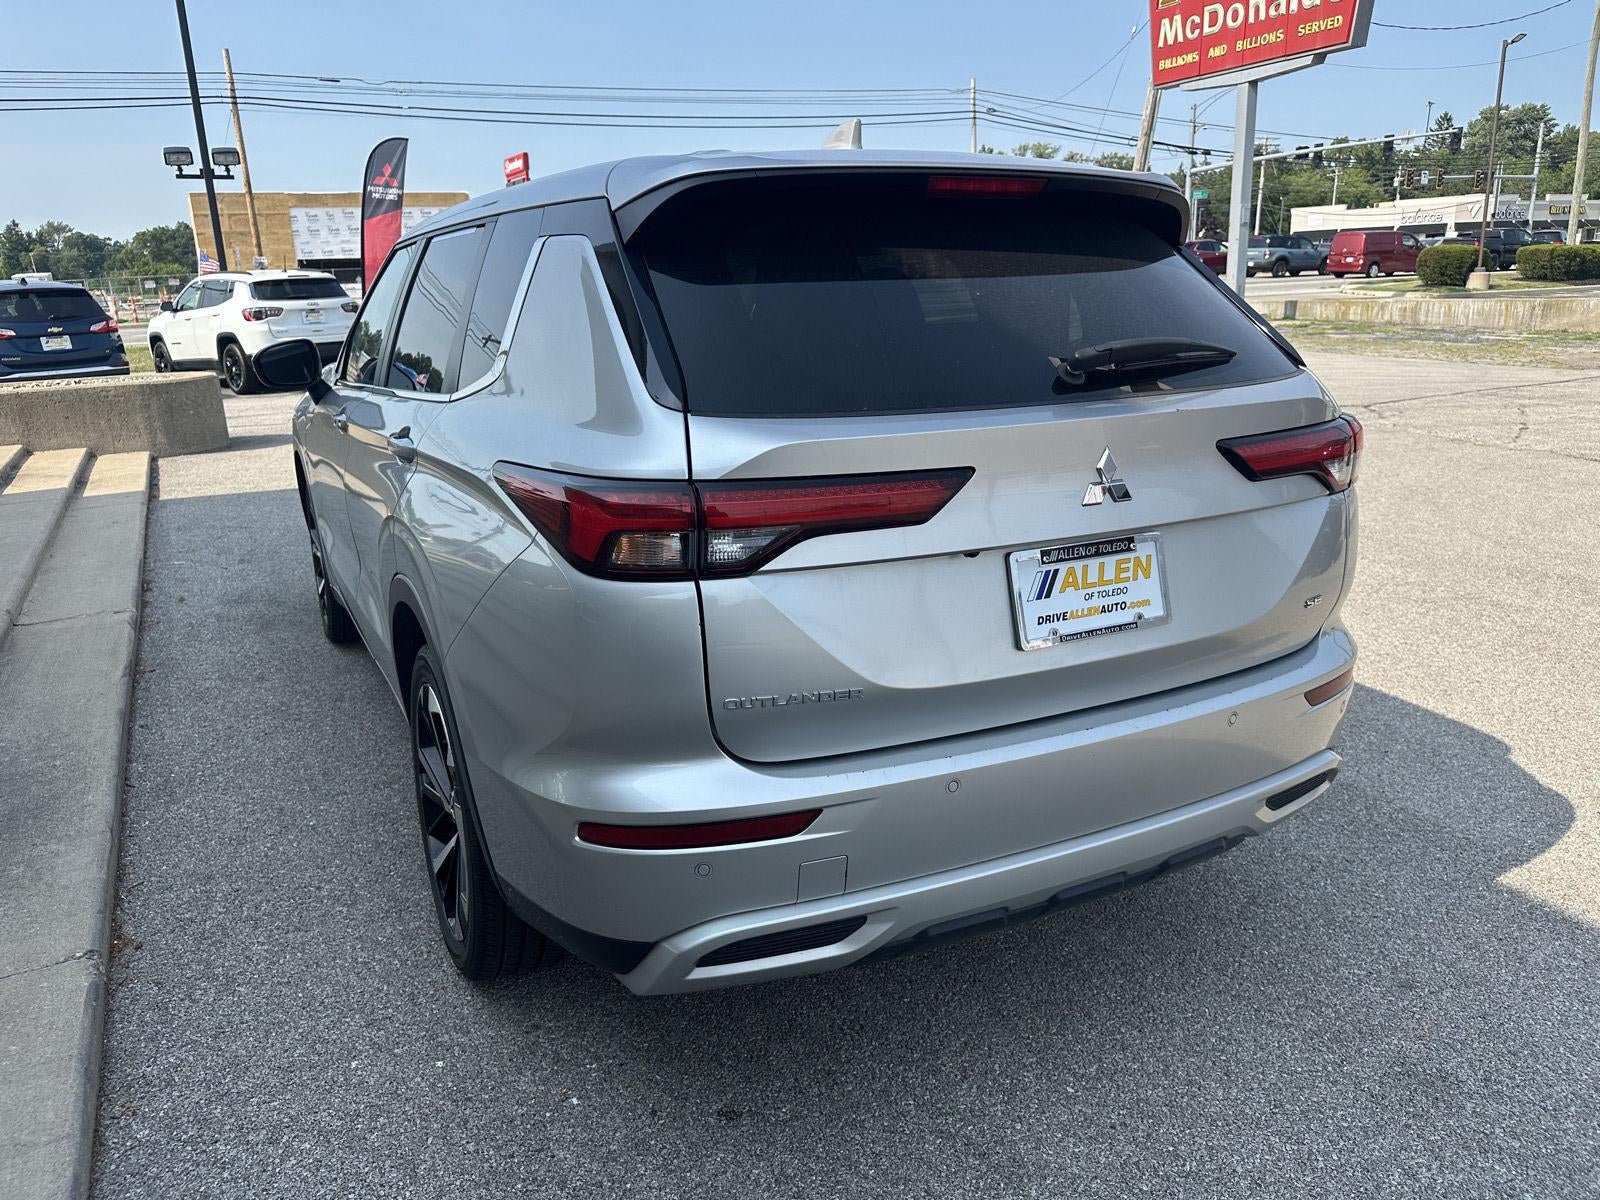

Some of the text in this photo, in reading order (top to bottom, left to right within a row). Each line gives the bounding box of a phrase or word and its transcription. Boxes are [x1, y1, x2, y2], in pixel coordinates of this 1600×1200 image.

[1157, 0, 1342, 48] McDona
[1158, 15, 1344, 71] BILLIONS AND BILLIONS SERVED
[371, 192, 399, 201] MOTORS
[1058, 541, 1129, 560] ALLEN OF TOLEDO
[1059, 554, 1152, 593] ALLEN
[1084, 586, 1128, 601] OF TOLEDO
[1037, 599, 1151, 625] DRIVEALLENAUTO.com
[723, 688, 864, 709] OUTLANDER
